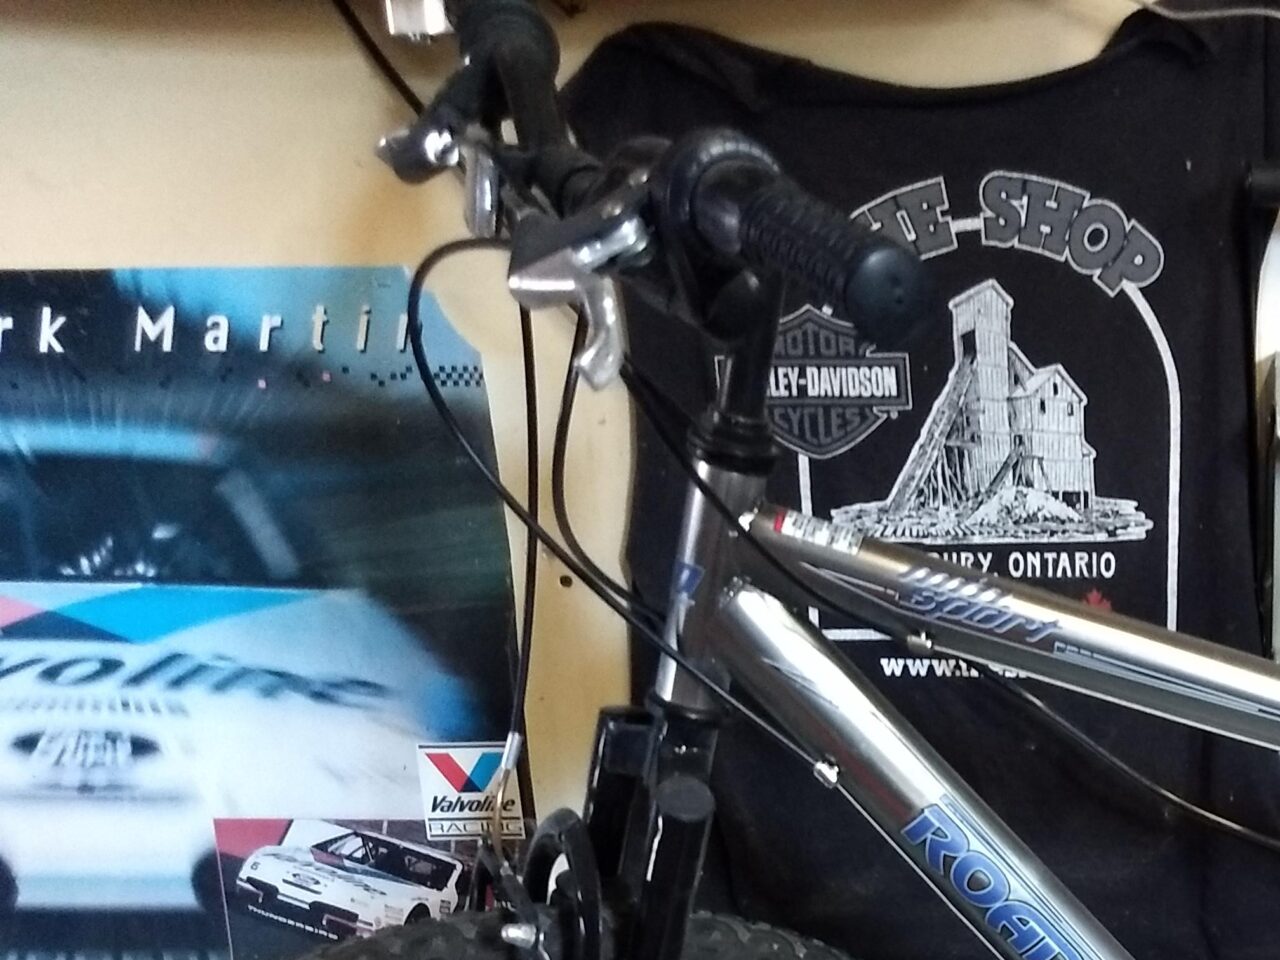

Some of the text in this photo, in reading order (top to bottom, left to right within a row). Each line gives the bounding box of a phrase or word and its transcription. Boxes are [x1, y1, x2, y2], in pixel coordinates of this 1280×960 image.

[979, 170, 1164, 297] SHOP
[0, 306, 67, 353] rk
[766, 365, 899, 399] LEY-DAVIDSON
[774, 406, 861, 444] CYCLES
[1008, 551, 1116, 578] ONTARIO
[910, 590, 1063, 643] sport
[431, 795, 516, 813] Valvolie
[428, 821, 523, 834] RACIG
